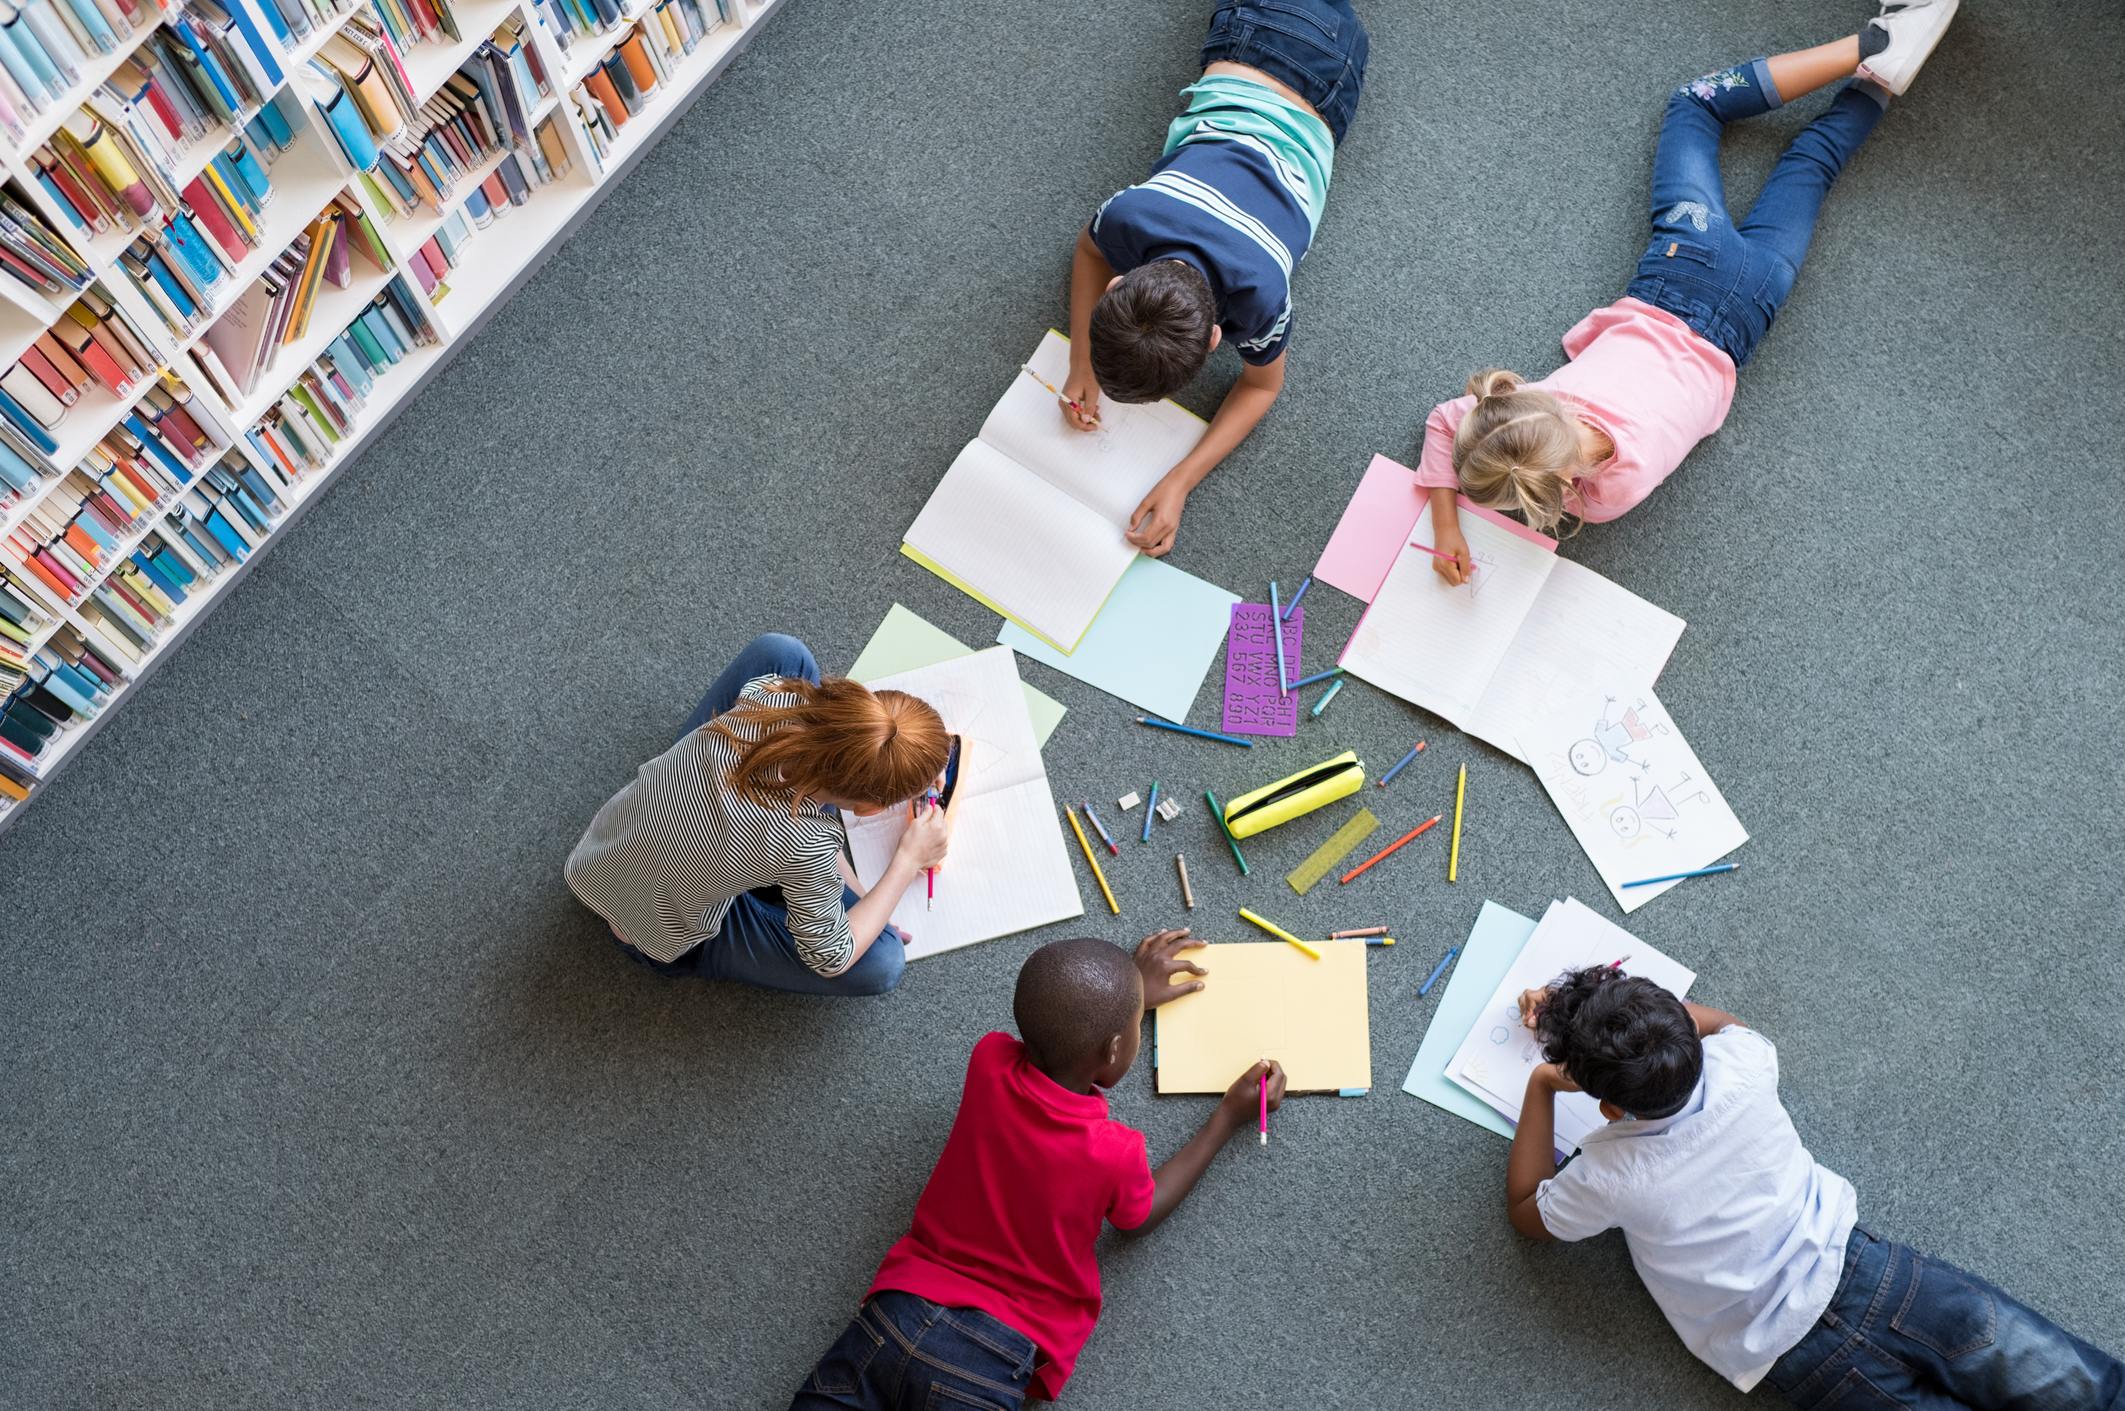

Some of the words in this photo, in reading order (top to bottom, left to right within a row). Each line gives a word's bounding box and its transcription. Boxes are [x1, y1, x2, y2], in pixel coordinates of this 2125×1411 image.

[344, 27, 354, 36] LIN
[353, 34, 364, 43] 833
[1234, 611, 1250, 642] 234
[1249, 612, 1265, 644] STU
[1282, 615, 1298, 647] ABC
[1231, 652, 1247, 684] 567
[1247, 652, 1263, 686] VWX
[1263, 653, 1278, 687] MNO
[1227, 693, 1244, 724] 890
[1243, 694, 1260, 725] YZ1
[1260, 695, 1276, 726] PQR
